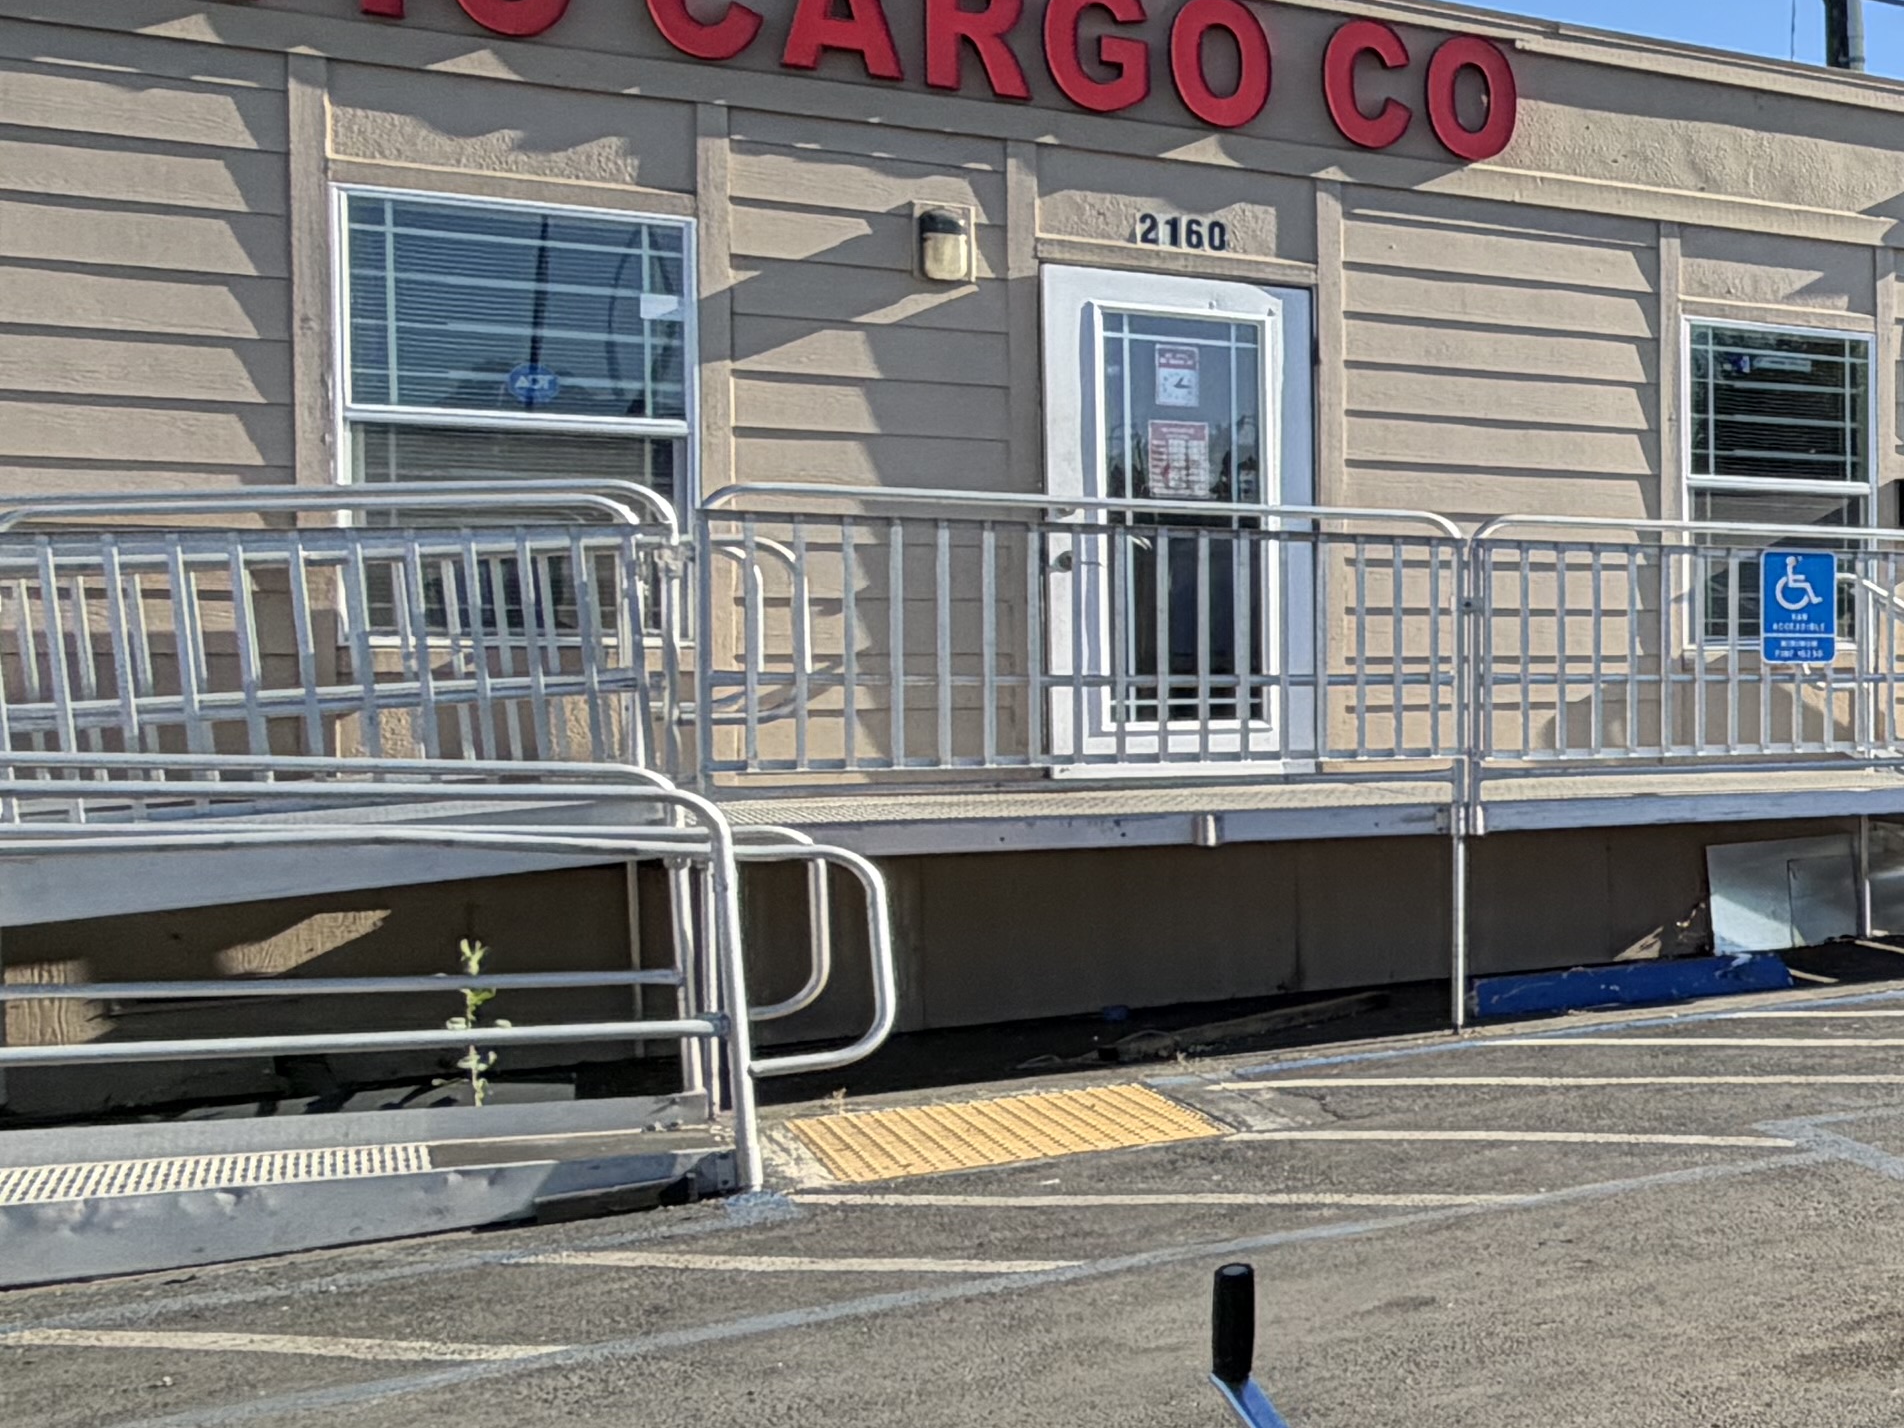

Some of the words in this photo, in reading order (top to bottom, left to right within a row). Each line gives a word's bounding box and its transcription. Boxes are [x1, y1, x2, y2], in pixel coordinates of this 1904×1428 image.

[1320, 19, 1518, 161] CO
[1138, 213, 1227, 251] 2160
[514, 374, 554, 390] ADT
